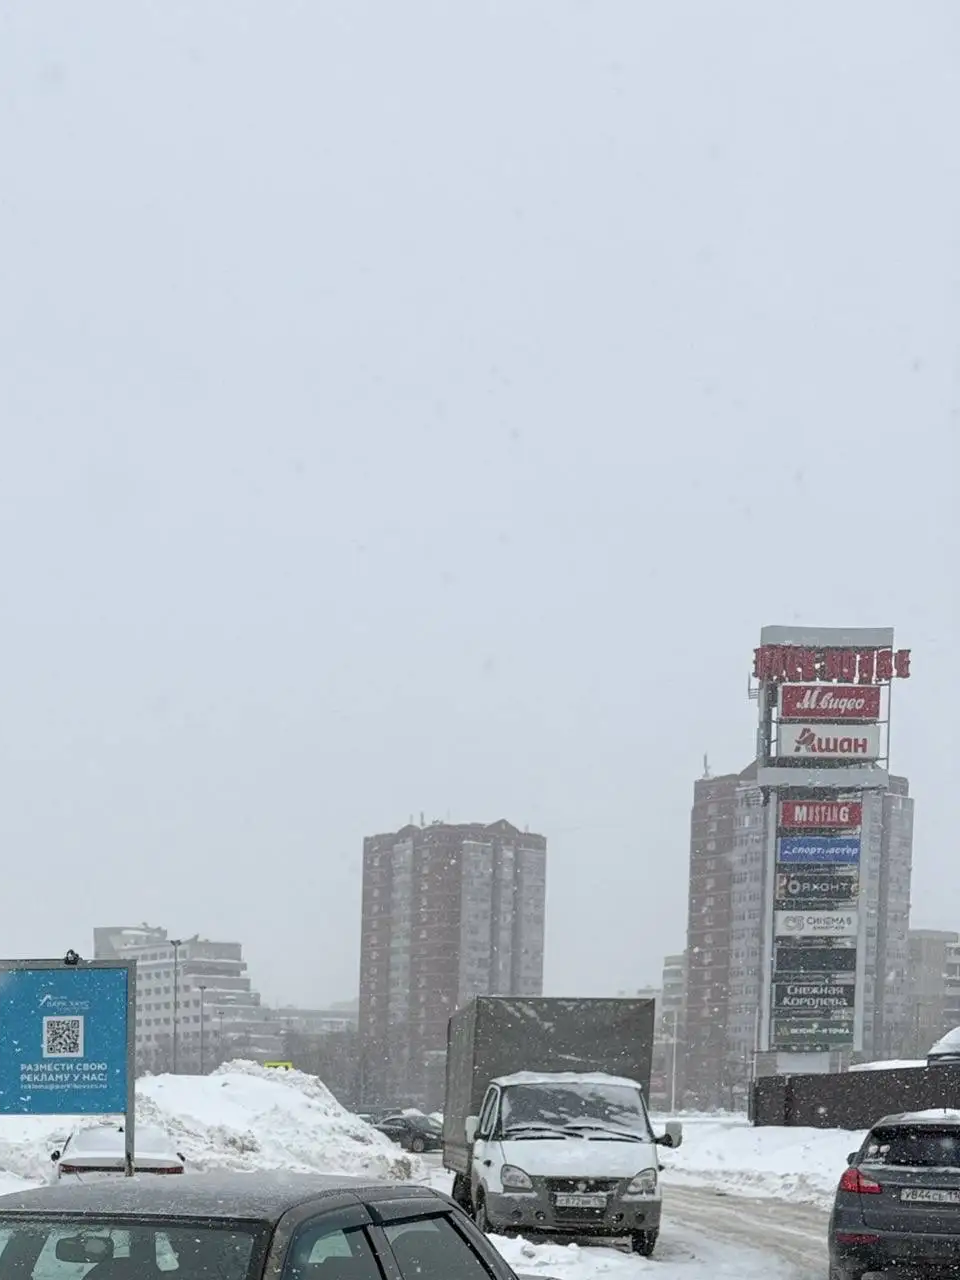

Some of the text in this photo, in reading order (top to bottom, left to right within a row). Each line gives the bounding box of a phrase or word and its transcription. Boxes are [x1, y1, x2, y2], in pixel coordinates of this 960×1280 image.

[794, 728, 868, 754] Ашан
[794, 806, 850, 822] MUSTANG
[20, 1062, 107, 1072] РАЗМЕСТИ СВОЮ
[20, 1073, 70, 1082] РЕКЛАМУ
[72, 1073, 80, 1082] У
